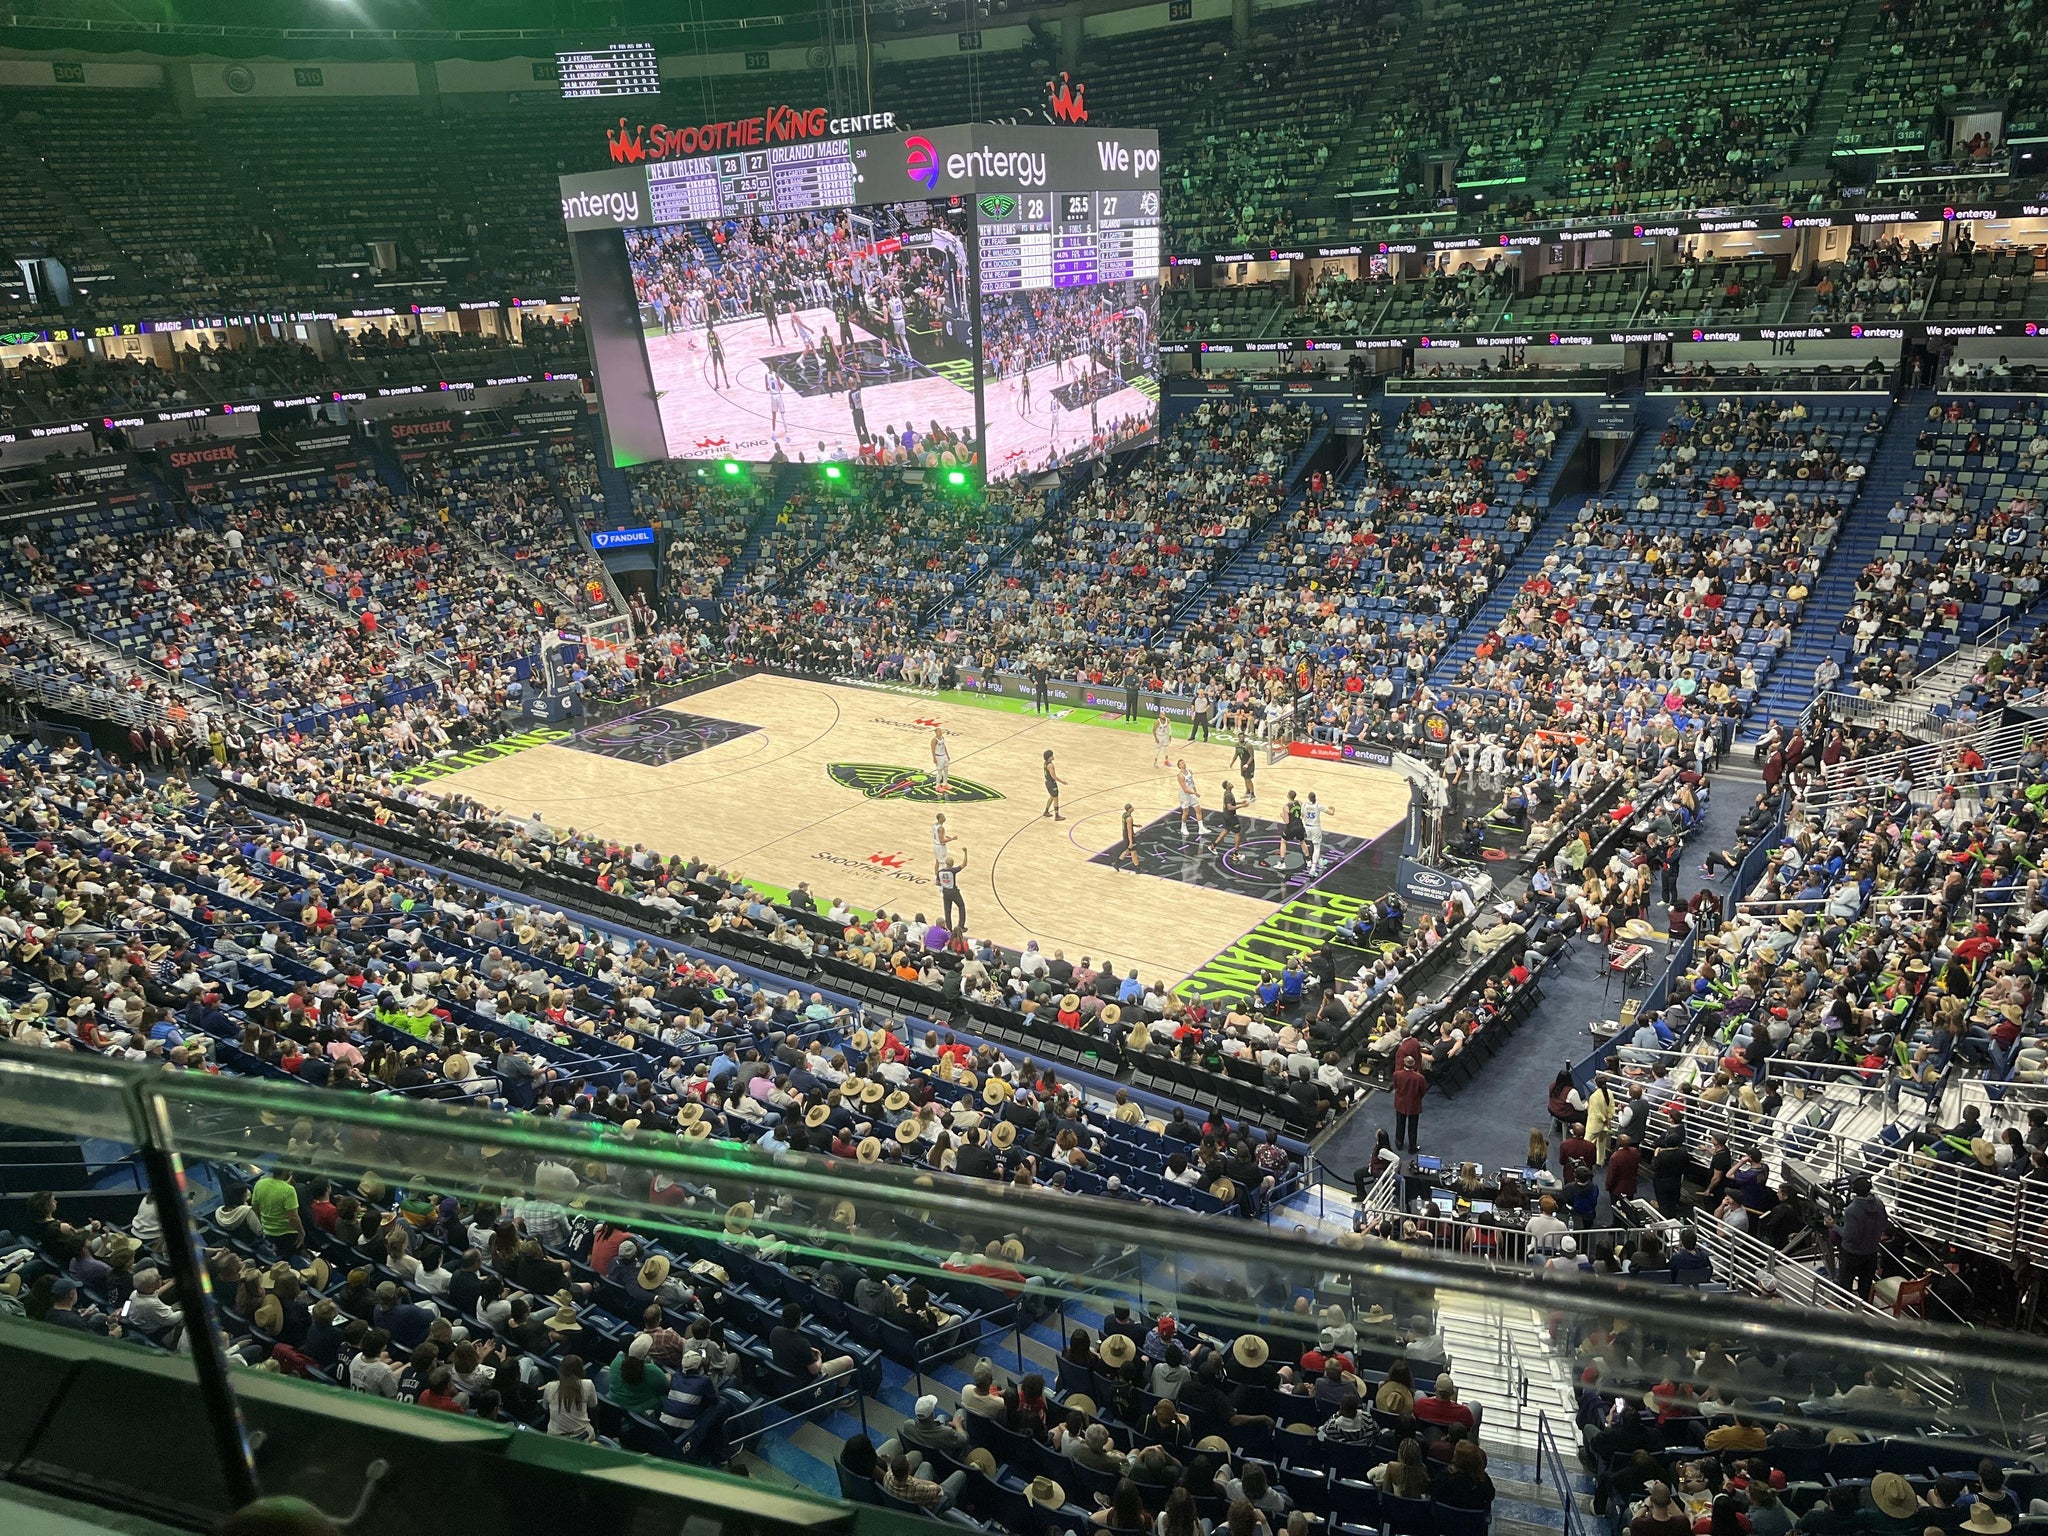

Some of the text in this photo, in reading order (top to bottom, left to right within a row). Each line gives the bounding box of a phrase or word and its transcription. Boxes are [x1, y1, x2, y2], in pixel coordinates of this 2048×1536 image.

[1171, 4, 1189, 17] 314
[748, 56, 767, 66] 312
[55, 67, 82, 80] 309
[298, 72, 320, 83] 310
[649, 117, 764, 159] SMOOTHIE
[830, 112, 894, 135] CENTER
[1898, 131, 1913, 139] 318
[772, 140, 848, 163] ORLANDO MAGIC
[1098, 142, 1128, 171] We
[725, 160, 736, 172] 28
[751, 156, 762, 169] 27
[947, 146, 1046, 186] entergy
[651, 158, 711, 179] NEW ORLEANS
[741, 180, 756, 190] 25.5
[1028, 199, 1043, 219] 28
[1070, 197, 1088, 213] 25.5
[1104, 197, 1117, 216] 27
[2023, 205, 2038, 215] We
[1956, 208, 1996, 220] entergy
[1700, 222, 1714, 232] We
[1715, 221, 1741, 232] power
[1794, 216, 1831, 227] entergy
[979, 224, 1016, 236] NEW ORLEANS
[1059, 224, 1091, 235] 3 FOULS 5
[1644, 226, 1678, 236] entergy
[909, 231, 932, 243] entergy
[1059, 237, 1091, 247] 6 6
[1388, 243, 1416, 253] entergy
[1433, 240, 1444, 249] We
[1445, 240, 1466, 249] power
[1225, 253, 1242, 262] power
[1278, 251, 1304, 260] entergy
[1177, 257, 1201, 266] entergy
[470, 302, 491, 311] power
[521, 298, 546, 307] entergy
[95, 324, 136, 336] 25.5 27
[155, 321, 182, 332] MAGIC
[1926, 326, 1942, 336] We
[1944, 326, 1977, 336] power
[54, 330, 68, 340] 28
[1704, 331, 1740, 342] entergy
[1864, 327, 1903, 338] entergy
[1314, 341, 1341, 351] entergy
[1355, 339, 1366, 348] We
[1367, 339, 1390, 350] power
[1560, 335, 1592, 346] entergy
[1208, 343, 1232, 352] entergy
[1771, 340, 1795, 356] 114
[448, 381, 474, 390] entergy
[486, 378, 497, 386] We
[498, 377, 518, 386] power
[341, 392, 367, 401] entergy
[391, 387, 411, 396] power
[455, 388, 476, 402] 108
[233, 404, 261, 414] entergy
[158, 412, 171, 422] We
[172, 410, 191, 421] power
[391, 420, 453, 439] SEATGEEK
[169, 446, 239, 468] SEATGEEK
[610, 533, 649, 542] FANDUEL
[593, 588, 604, 601] 15
[890, 686, 939, 697] Health
[1019, 684, 1030, 693] We
[1096, 697, 1127, 710] entergy
[1146, 702, 1185, 716] We power
[1355, 751, 1389, 764] entergy
[811, 851, 885, 874] SMOOTHIE
